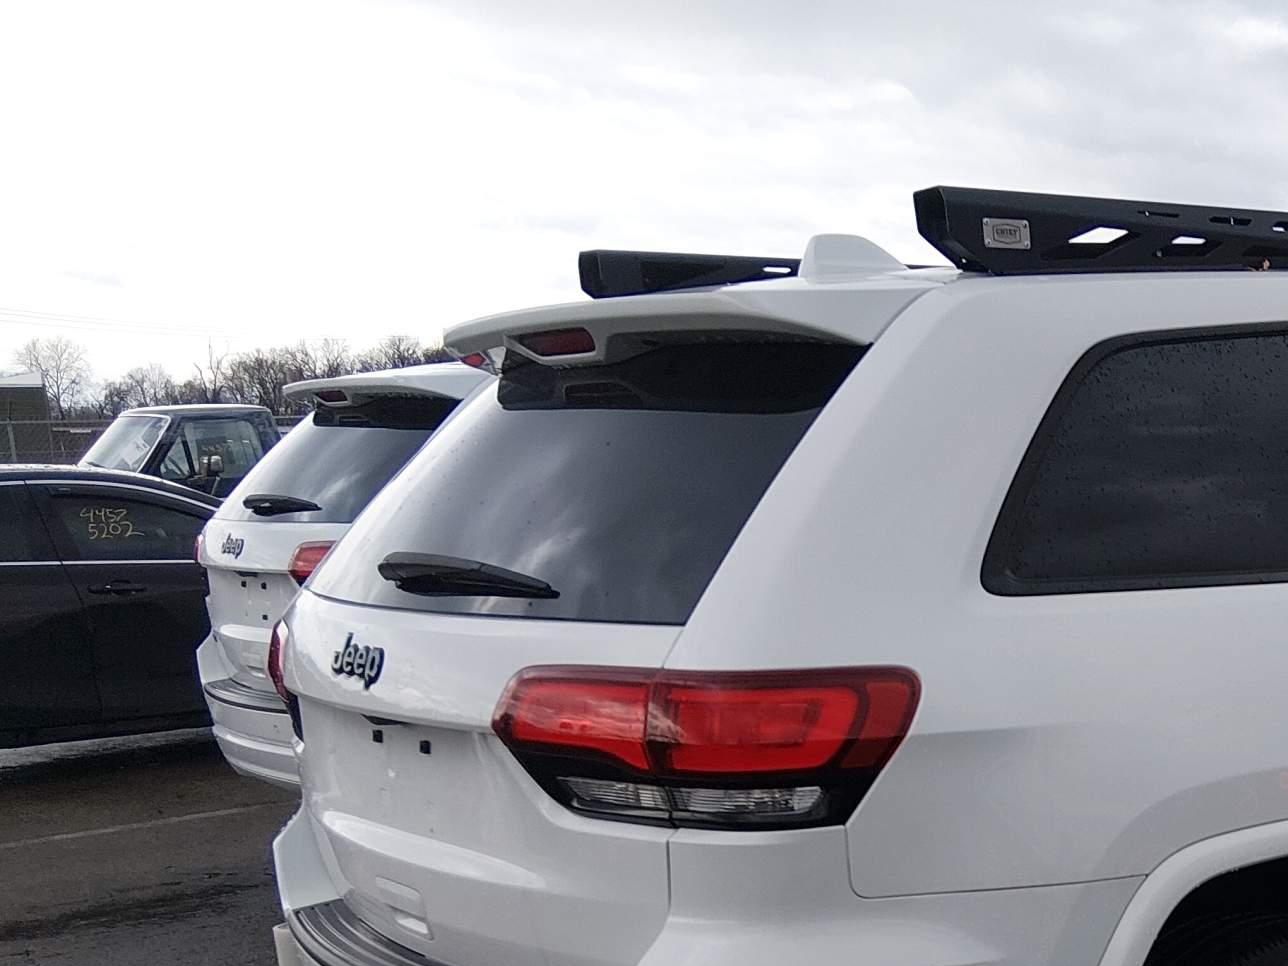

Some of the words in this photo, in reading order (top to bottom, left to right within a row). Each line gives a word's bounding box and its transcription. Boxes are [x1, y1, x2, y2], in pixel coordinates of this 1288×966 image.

[88, 521, 145, 539] 5202
[222, 533, 244, 559] Jeep
[331, 632, 385, 691] Jeep
